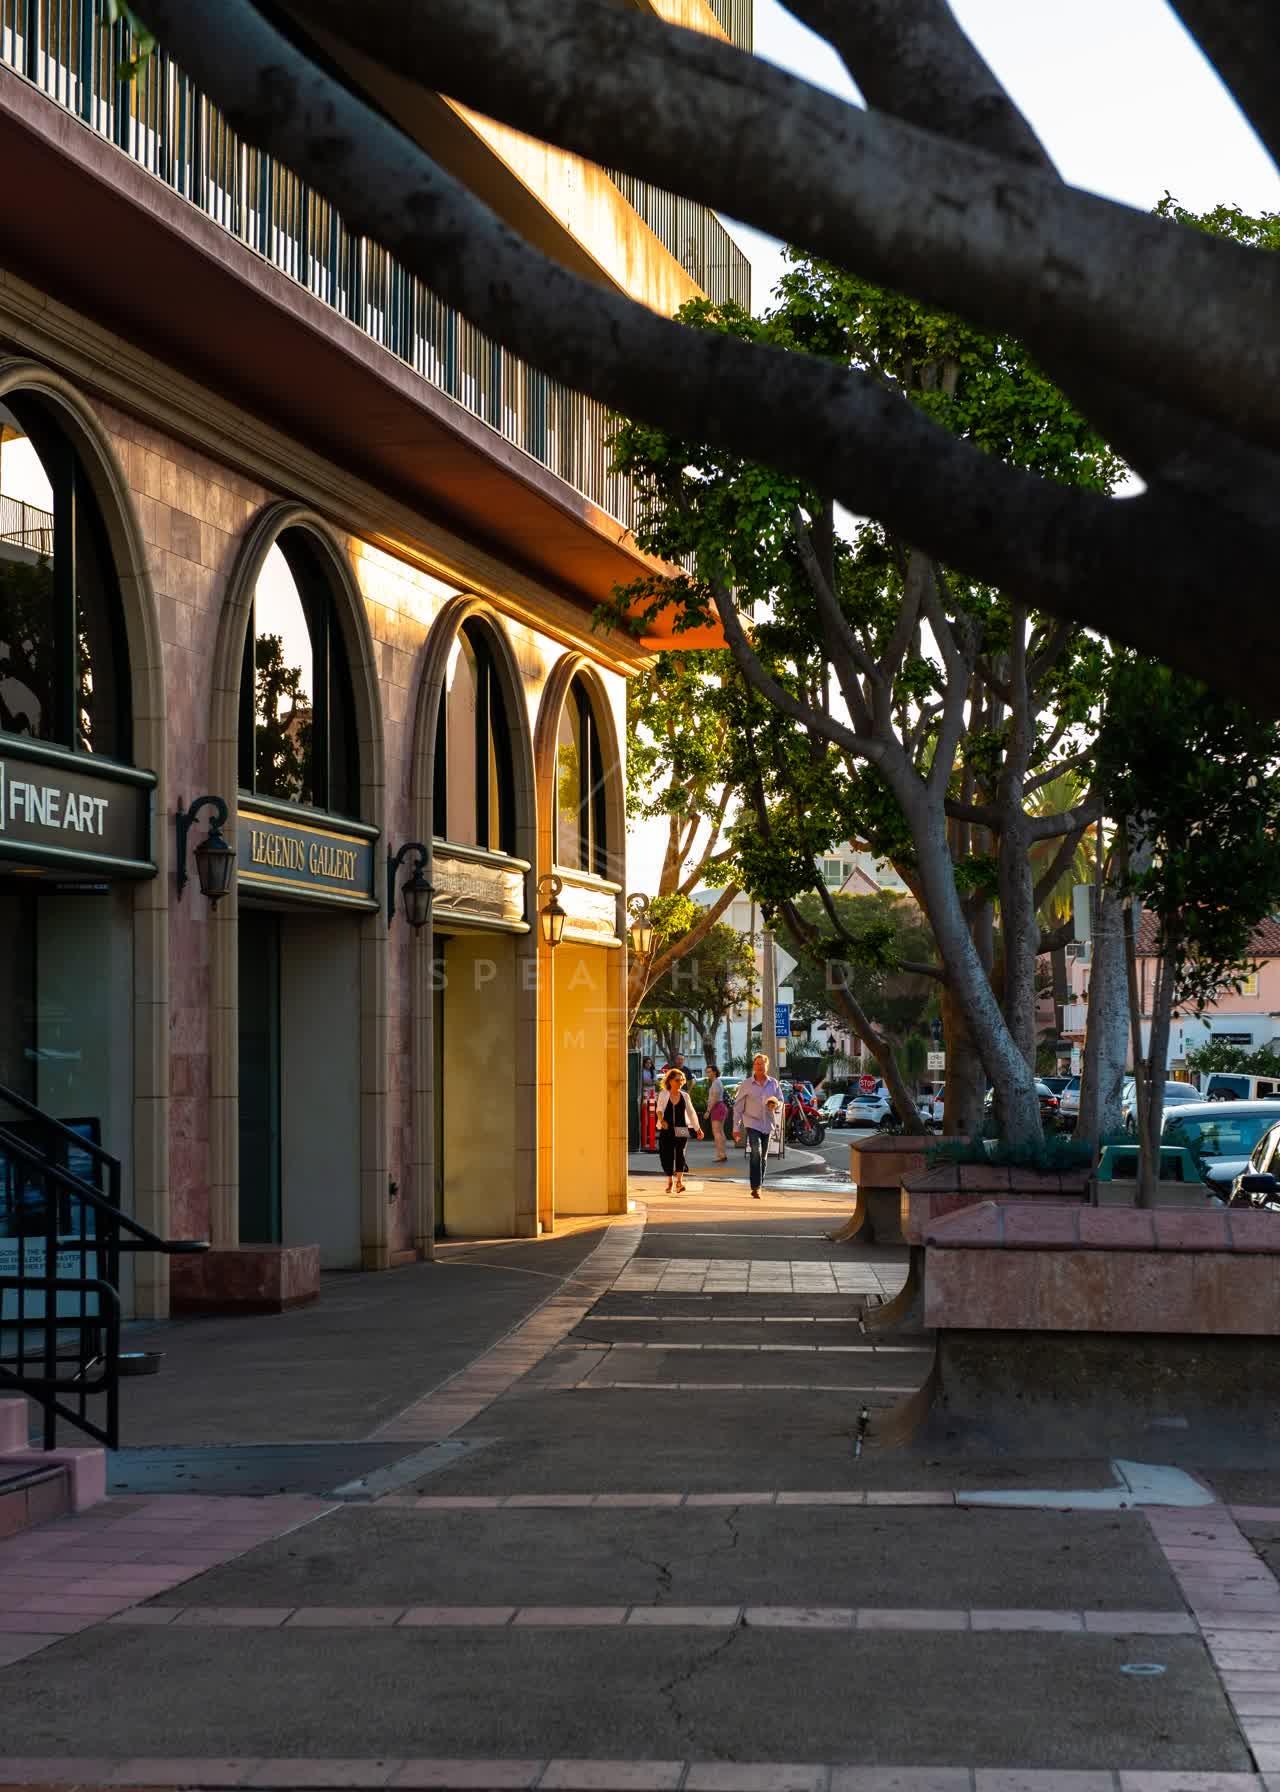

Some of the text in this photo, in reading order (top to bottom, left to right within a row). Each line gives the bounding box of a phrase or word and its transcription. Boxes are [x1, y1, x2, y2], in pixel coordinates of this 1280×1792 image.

[9, 780, 109, 836] FINE ART
[251, 830, 357, 880] LEGENDS GALLERY
[859, 1079, 875, 1087] STOP
